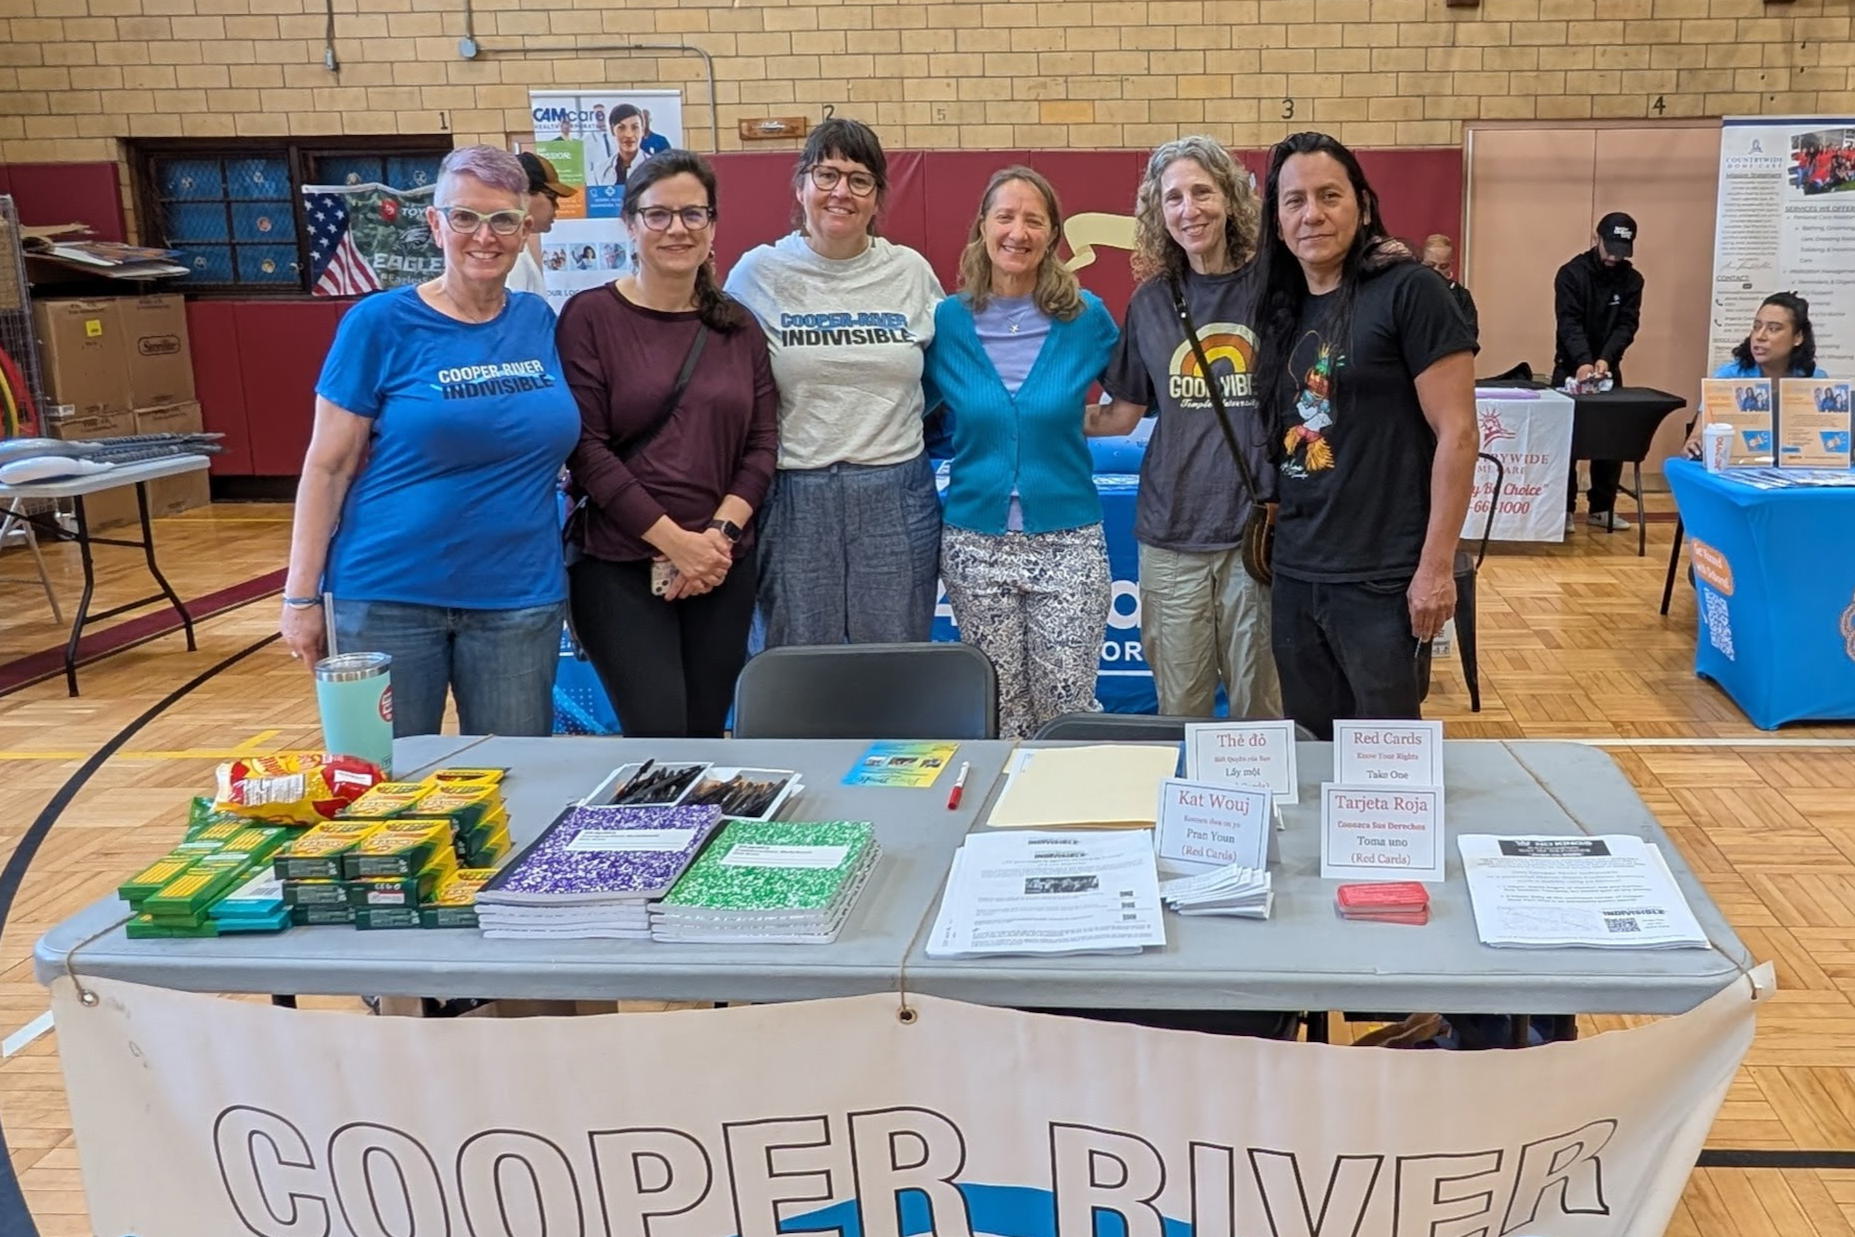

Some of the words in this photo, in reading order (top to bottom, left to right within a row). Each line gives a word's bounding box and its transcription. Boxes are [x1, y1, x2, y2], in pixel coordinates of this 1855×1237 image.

[1281, 99, 1295, 119] 3
[1652, 95, 1667, 116] 4
[439, 111, 449, 130] 1
[400, 207, 428, 218] TOY
[373, 252, 443, 272] EAGLE
[780, 312, 851, 328] COOPER
[856, 312, 907, 326] RIVER
[781, 327, 916, 347] INDIVISIBLE
[438, 364, 499, 383] COOPER
[501, 359, 545, 377] RIVER
[441, 375, 555, 400] INDIVISIBLE
[1353, 732, 1380, 745] Red
[1383, 732, 1423, 745] Cards
[1366, 770, 1389, 779] Take
[1390, 770, 1409, 779] One
[1178, 790, 1205, 807] Kat
[1209, 793, 1251, 816] Wouj
[1335, 795, 1389, 812] Tarjeta
[1394, 797, 1428, 815] Roja
[1187, 828, 1208, 840] Pran
[1210, 831, 1235, 843] Youn
[1357, 835, 1386, 847] Toma
[1388, 837, 1408, 847] uno
[1181, 844, 1204, 856] (Red
[1205, 848, 1237, 863] Cards)
[1351, 854, 1376, 864] (Red
[1377, 855, 1411, 866] Cards)
[213, 1105, 976, 1237] COOPER
[1048, 1118, 1618, 1237] RIVER
